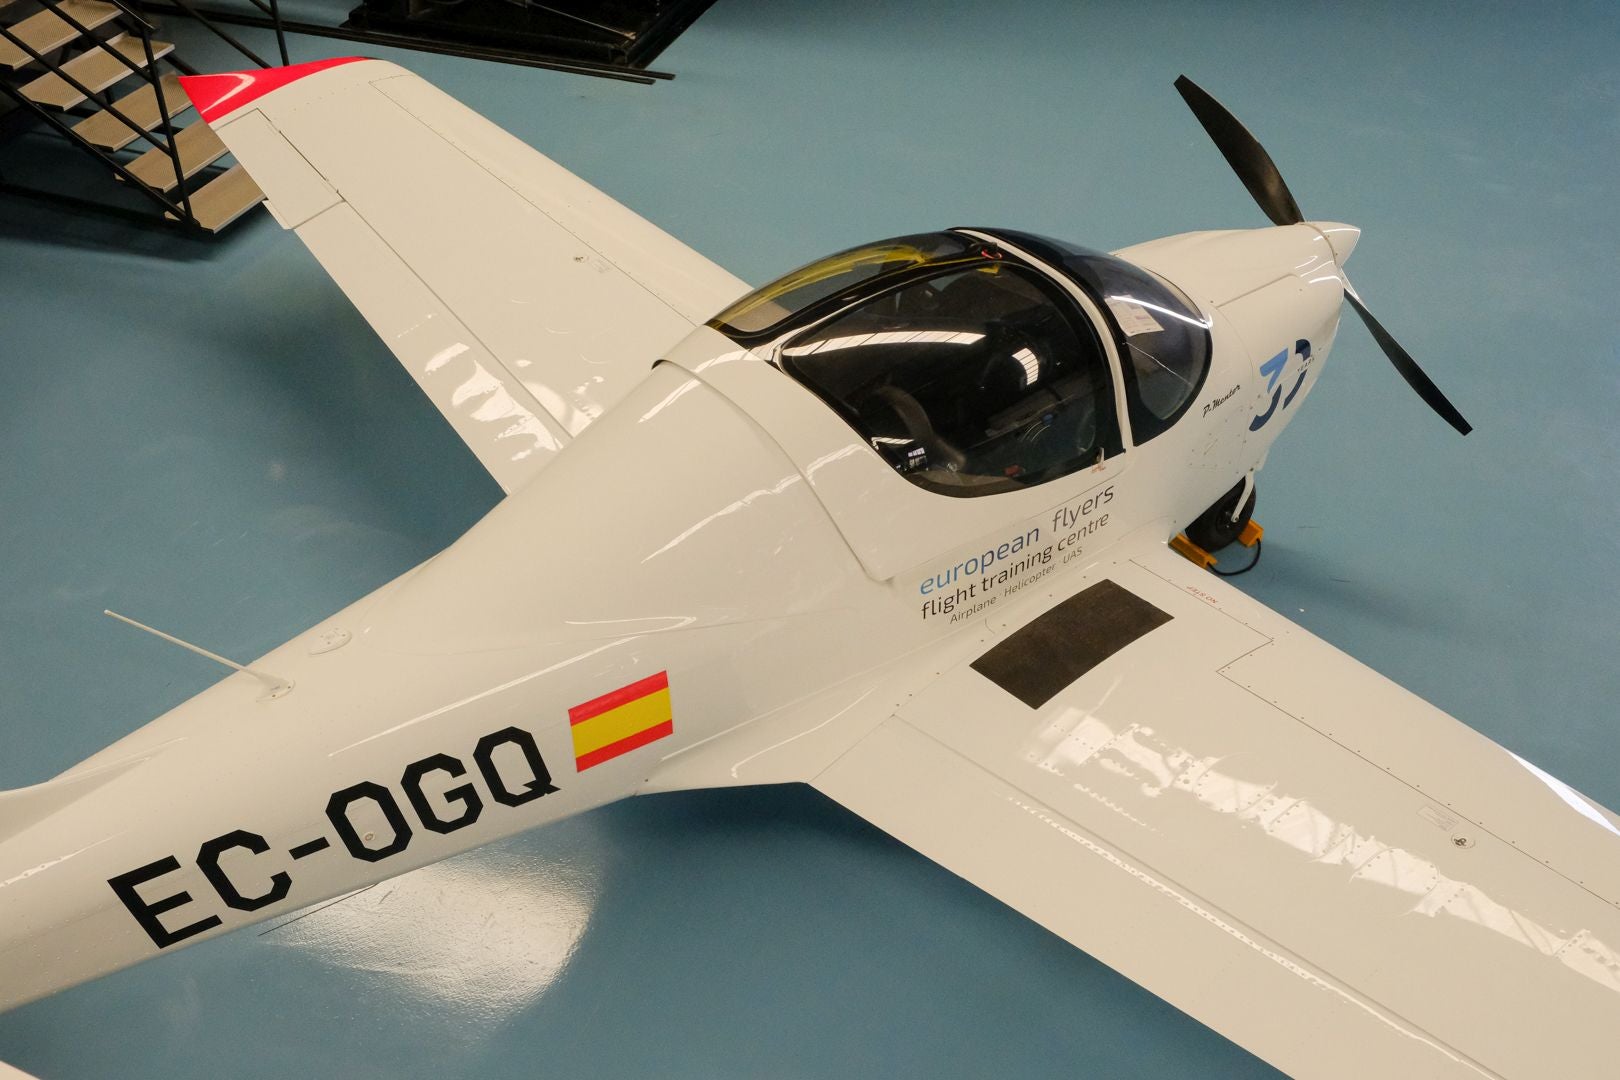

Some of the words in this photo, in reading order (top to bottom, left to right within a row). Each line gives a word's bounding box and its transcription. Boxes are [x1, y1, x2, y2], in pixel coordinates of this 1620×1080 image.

[920, 527, 1040, 595] european
[1052, 485, 1115, 532] flyers
[921, 583, 977, 620] flight
[982, 546, 1053, 592] training
[1057, 513, 1110, 551] centre
[950, 595, 998, 625] Airplane
[1004, 563, 1057, 597] Helicopter
[1063, 546, 1083, 564] UAS
[107, 725, 561, 949] EC-OGQ
